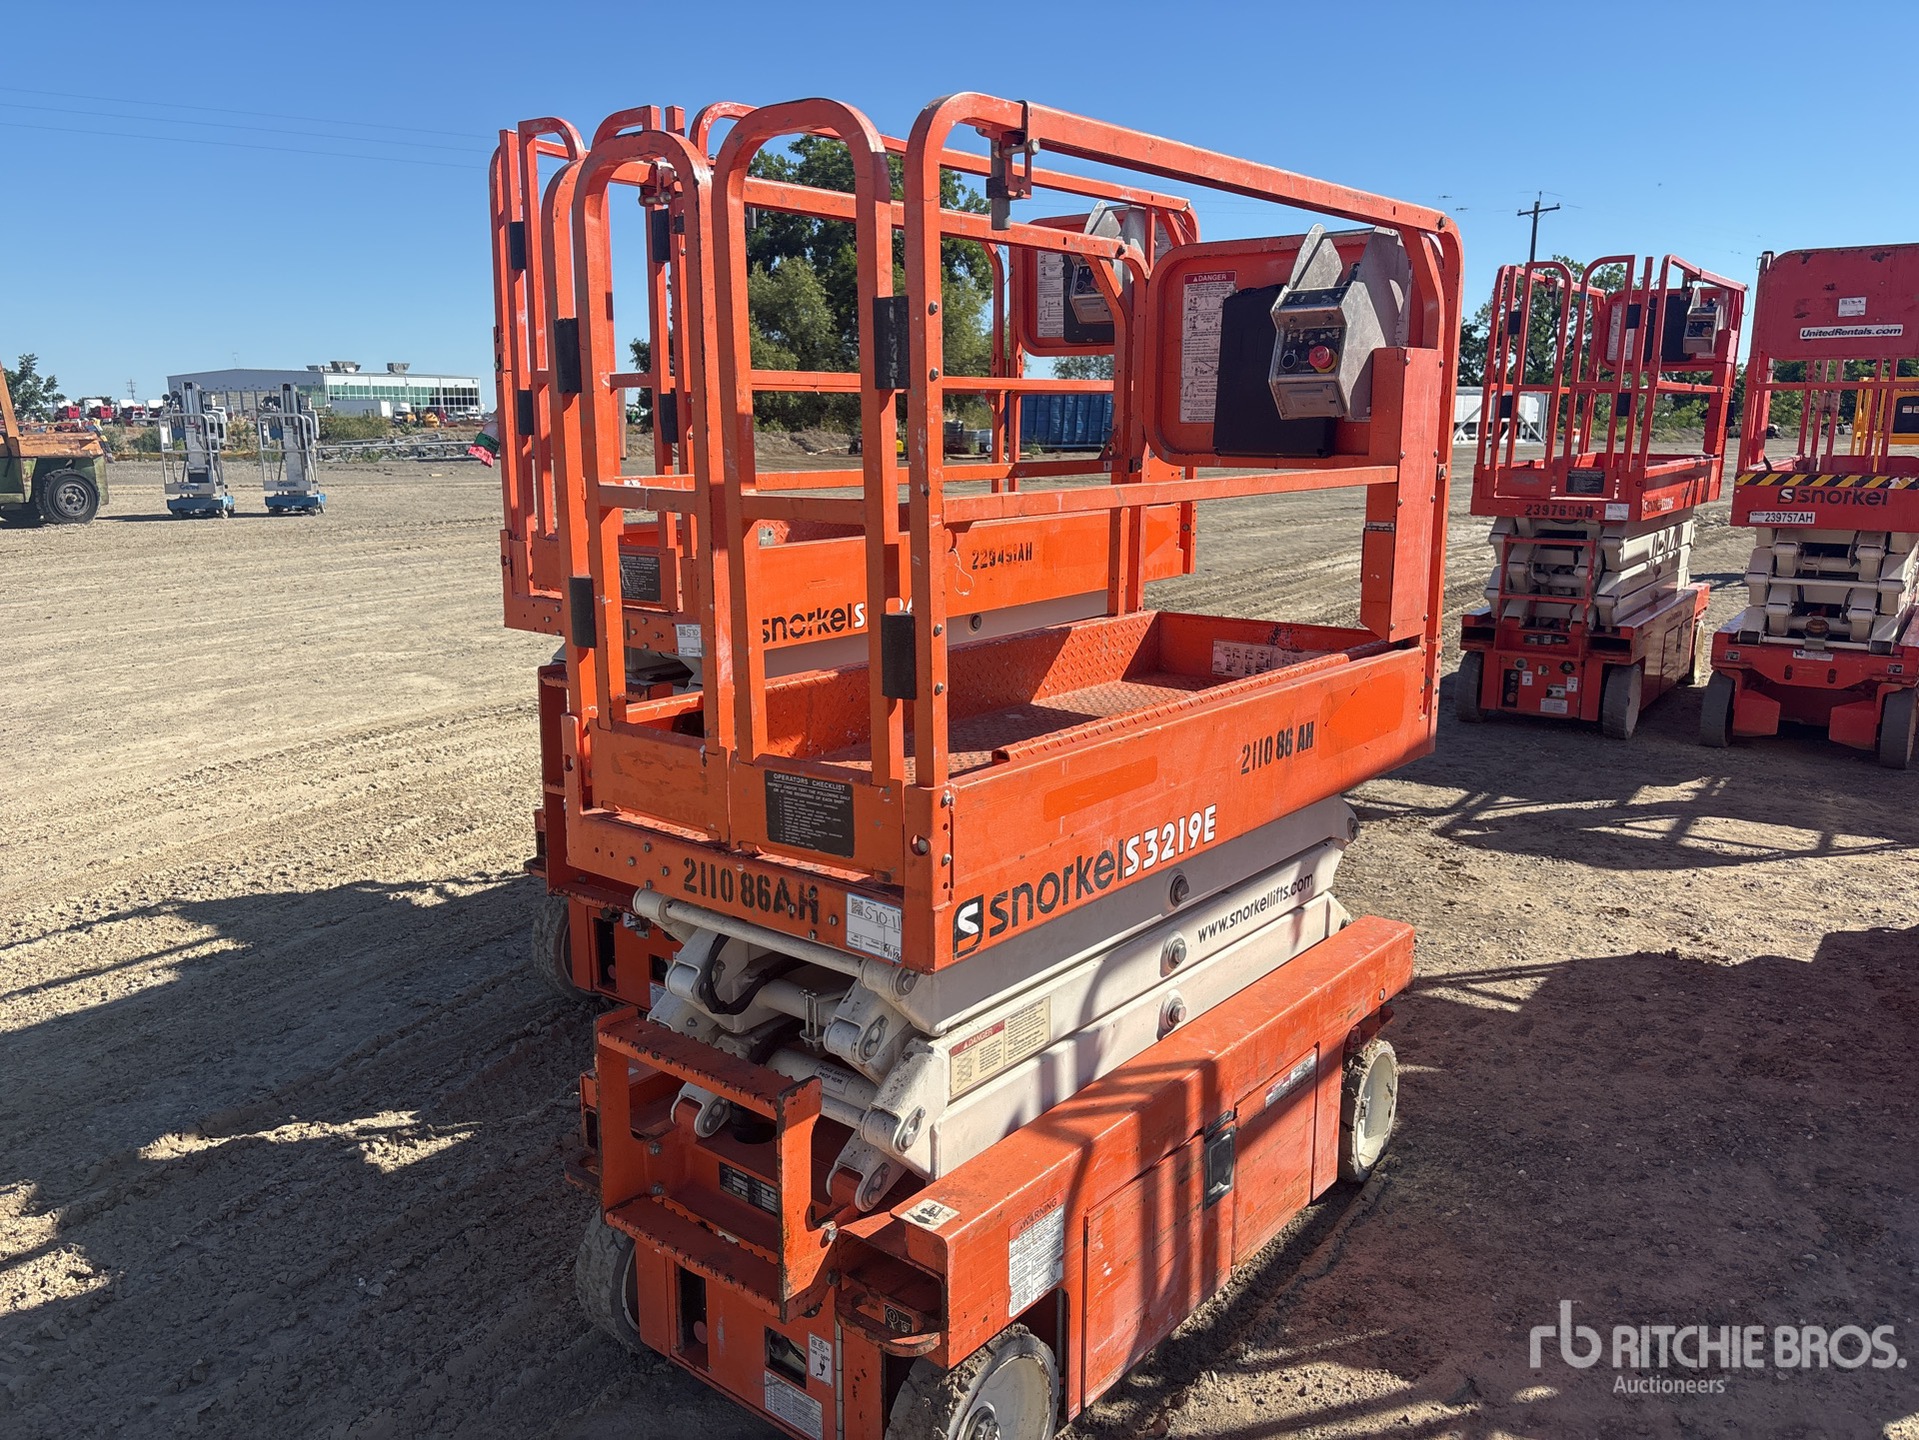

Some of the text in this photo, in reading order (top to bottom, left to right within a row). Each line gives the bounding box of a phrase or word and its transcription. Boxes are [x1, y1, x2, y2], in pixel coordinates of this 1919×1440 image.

[1199, 274, 1227, 282] DANGER
[1801, 327, 1902, 338] UnitedRentals.com
[1796, 488, 1890, 507] snorkel
[1765, 512, 1813, 523] 239757AH
[773, 773, 845, 791] OPERATORS CHECKLIST
[988, 838, 1123, 937] snorkel
[1123, 804, 1218, 879] S3219E
[1197, 873, 1314, 944] www.snorkellifts.com
[969, 1028, 994, 1047] DANGER
